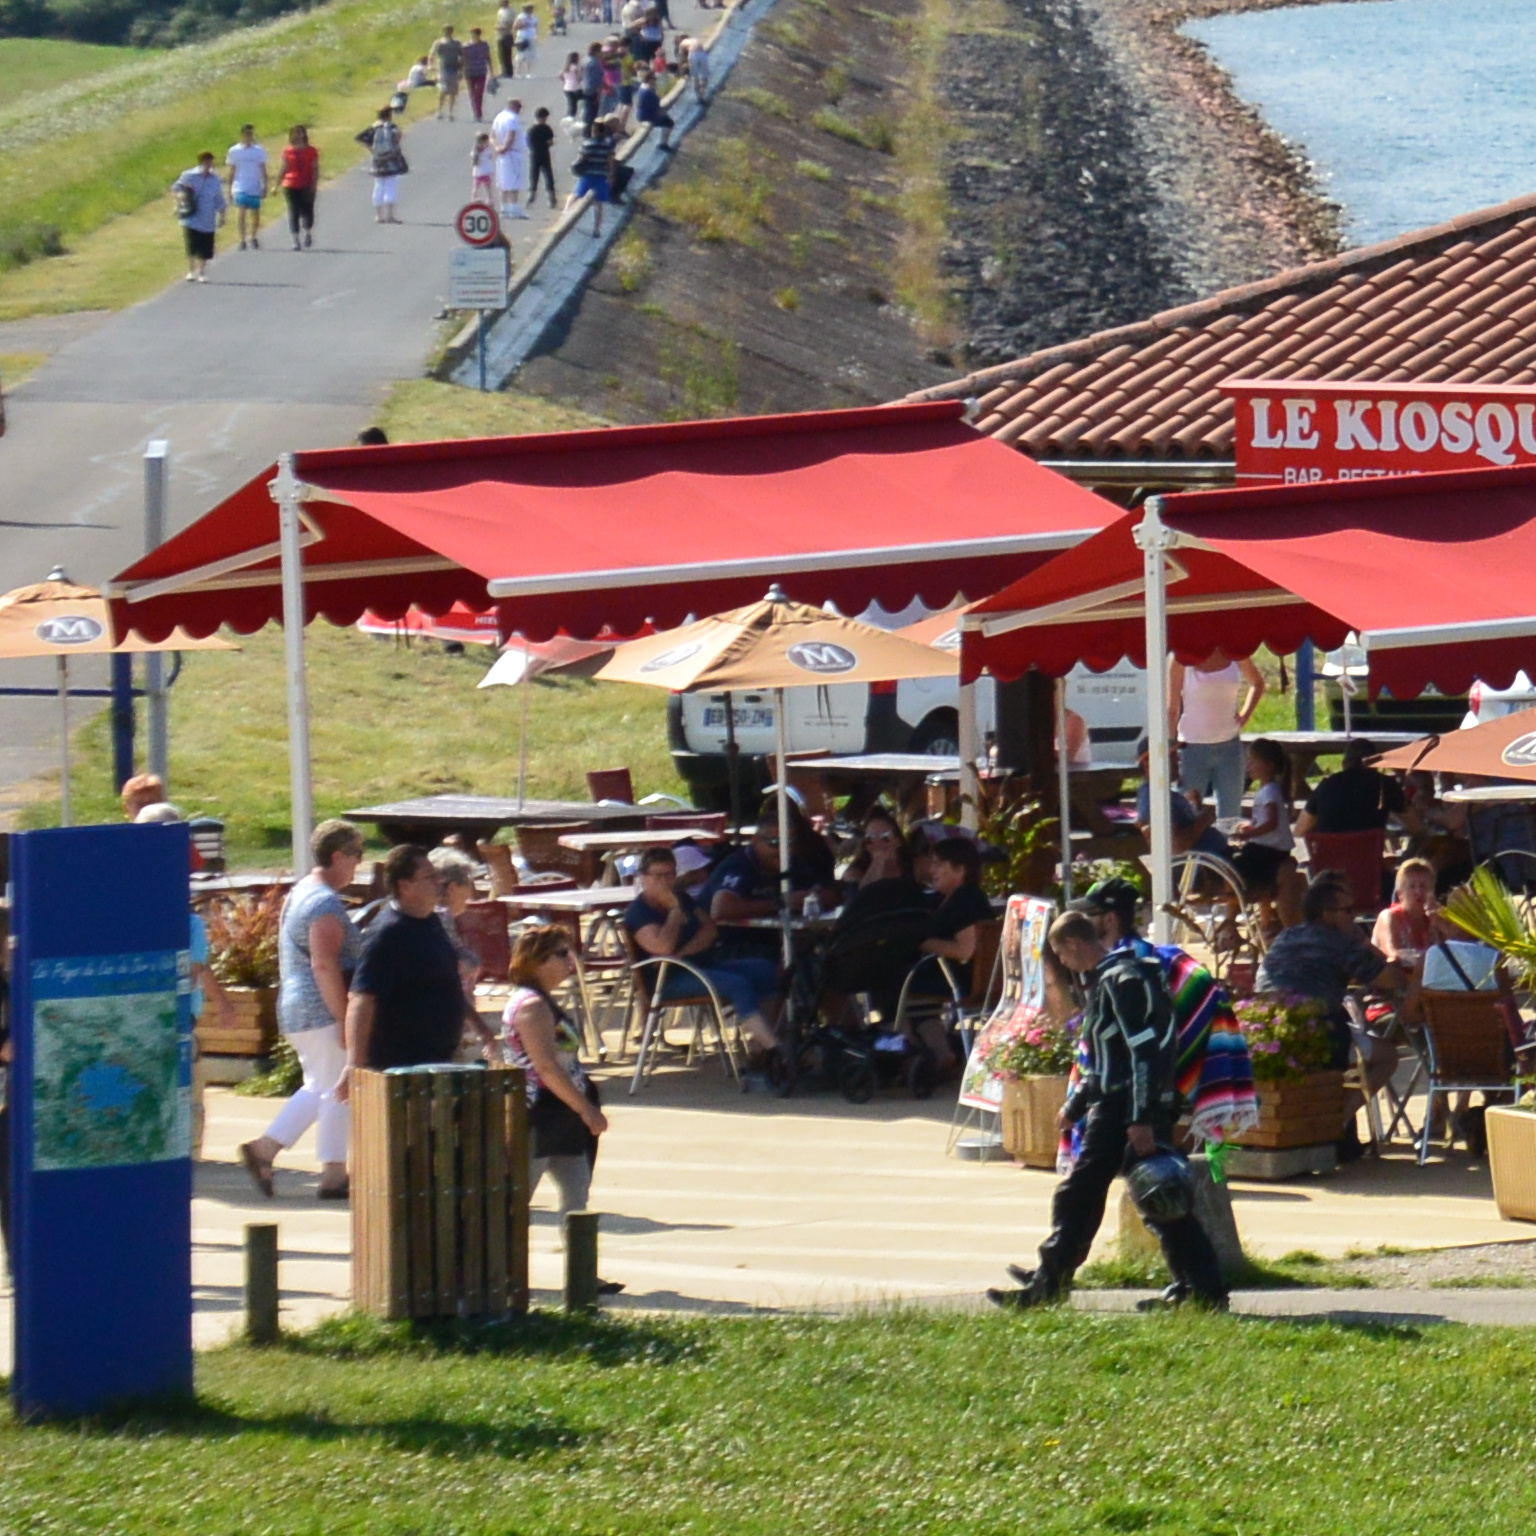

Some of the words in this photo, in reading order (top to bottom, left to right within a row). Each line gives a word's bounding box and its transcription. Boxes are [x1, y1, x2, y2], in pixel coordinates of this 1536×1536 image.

[464, 215, 490, 233] 30
[1250, 398, 1319, 449] LE
[1284, 468, 1322, 485] BAR
